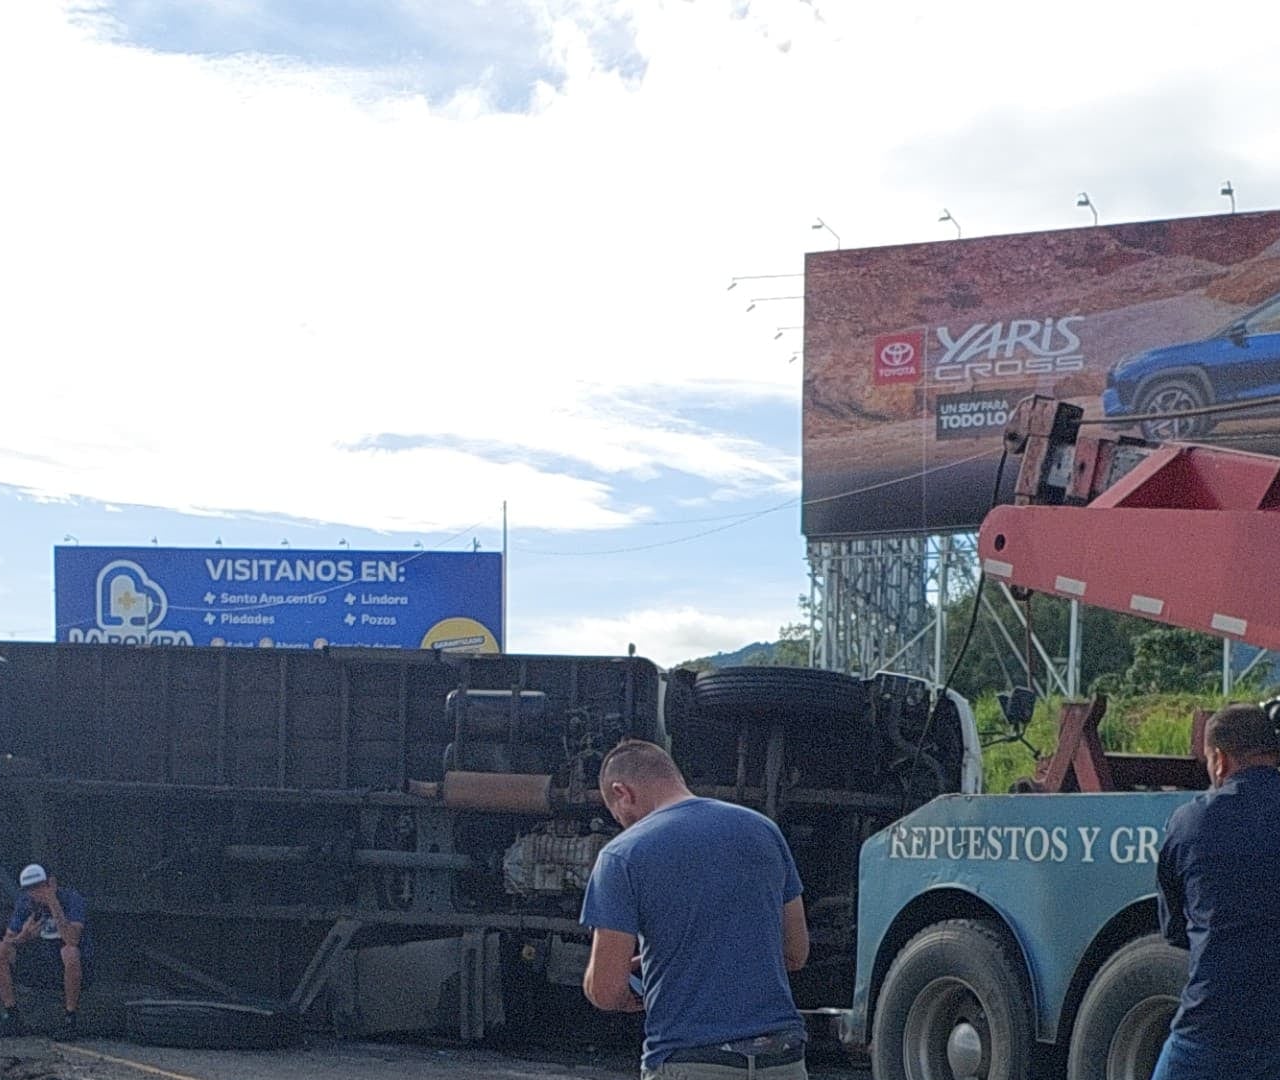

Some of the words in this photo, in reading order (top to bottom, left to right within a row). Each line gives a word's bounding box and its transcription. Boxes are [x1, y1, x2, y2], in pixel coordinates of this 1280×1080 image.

[879, 367, 916, 377] TOYOTA
[935, 355, 1084, 380] CROSS
[940, 404, 957, 414] UN
[958, 401, 980, 413] SUV
[940, 413, 985, 429] TODO
[986, 411, 1007, 426] LO
[205, 558, 354, 582] VISITANOS
[361, 560, 406, 583] EN:
[221, 593, 258, 604] Santa
[259, 593, 284, 604] Ana
[361, 594, 408, 605] Lindora
[221, 613, 275, 625] Piedades
[361, 614, 397, 625] Pozos
[889, 825, 1067, 863] REPUESTOS
[1077, 827, 1109, 863] Y
